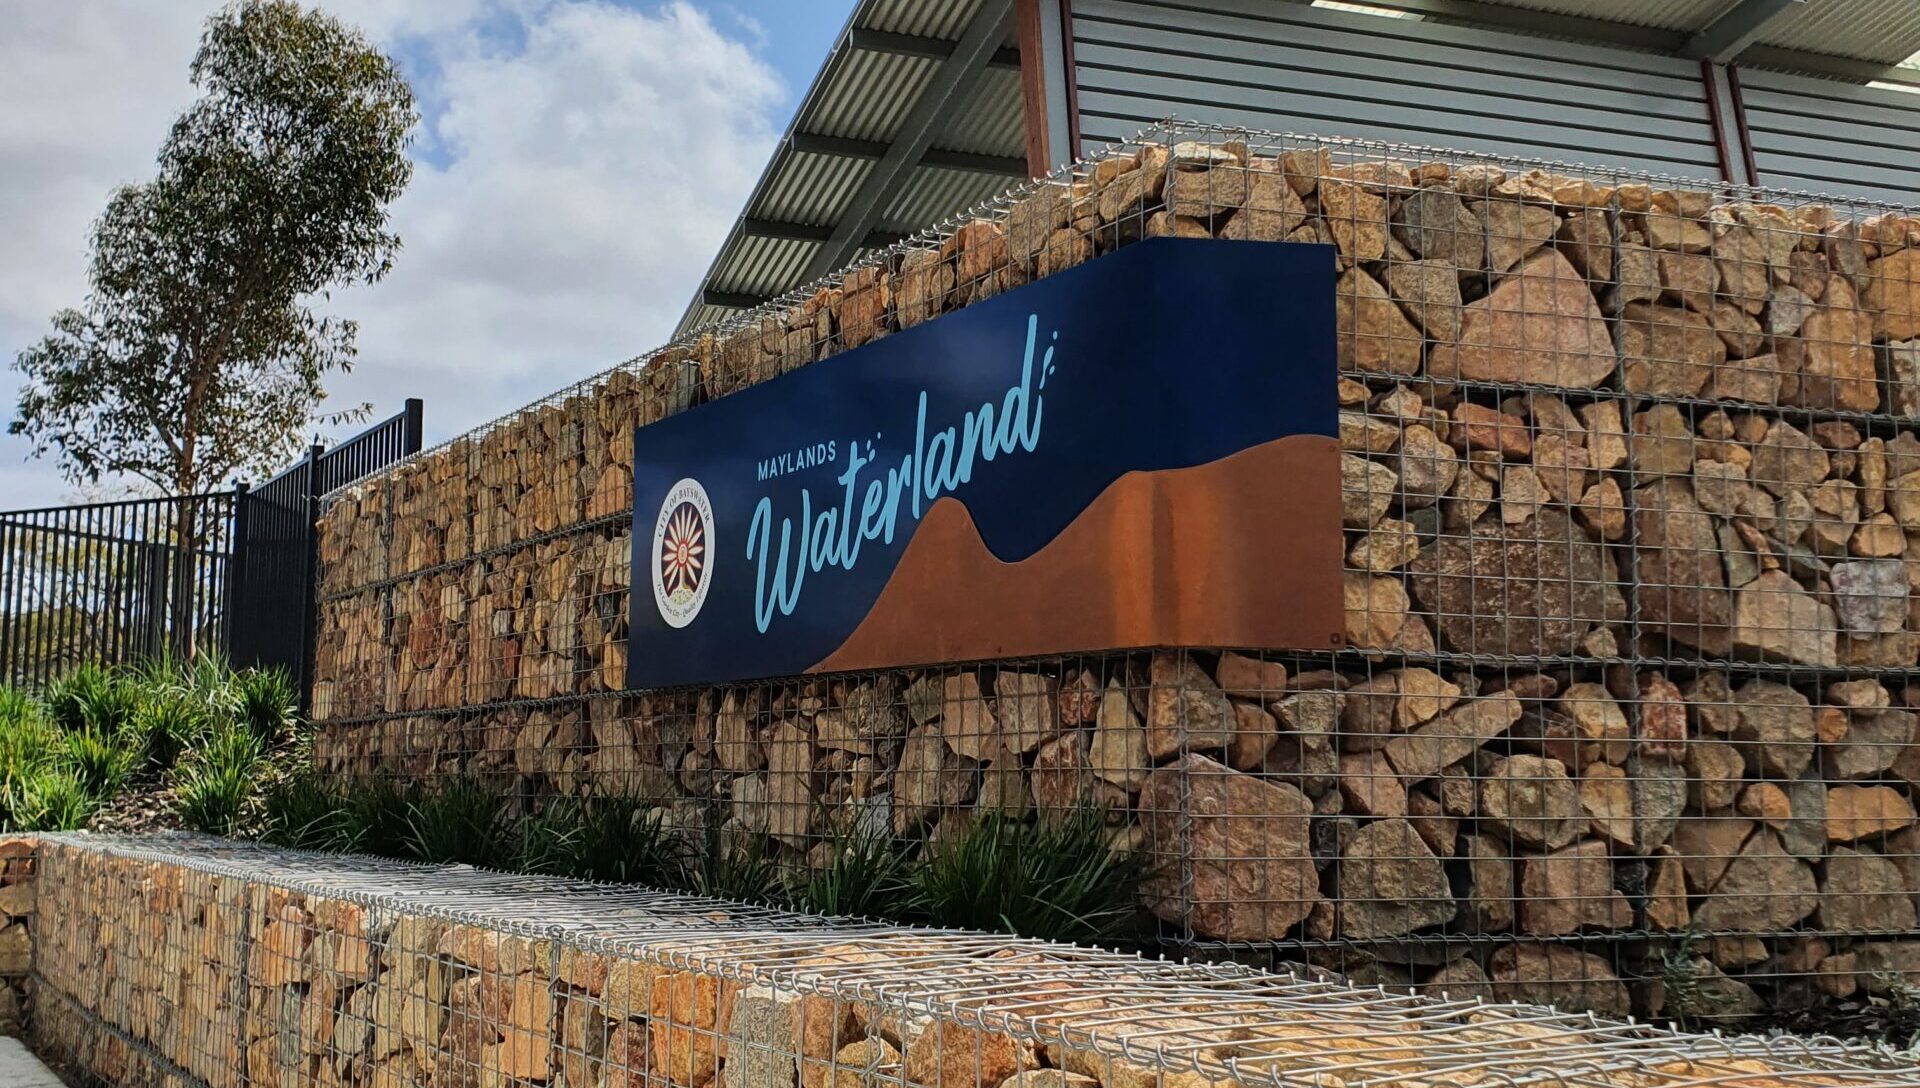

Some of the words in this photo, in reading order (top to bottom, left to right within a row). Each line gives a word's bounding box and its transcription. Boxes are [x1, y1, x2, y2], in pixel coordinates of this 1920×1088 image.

[746, 314, 1043, 634] Waterland
[758, 440, 836, 481] MAYLANDS
[657, 510, 669, 538] CITY
[669, 493, 679, 508] OF
[679, 487, 711, 524] BAYSWATER
